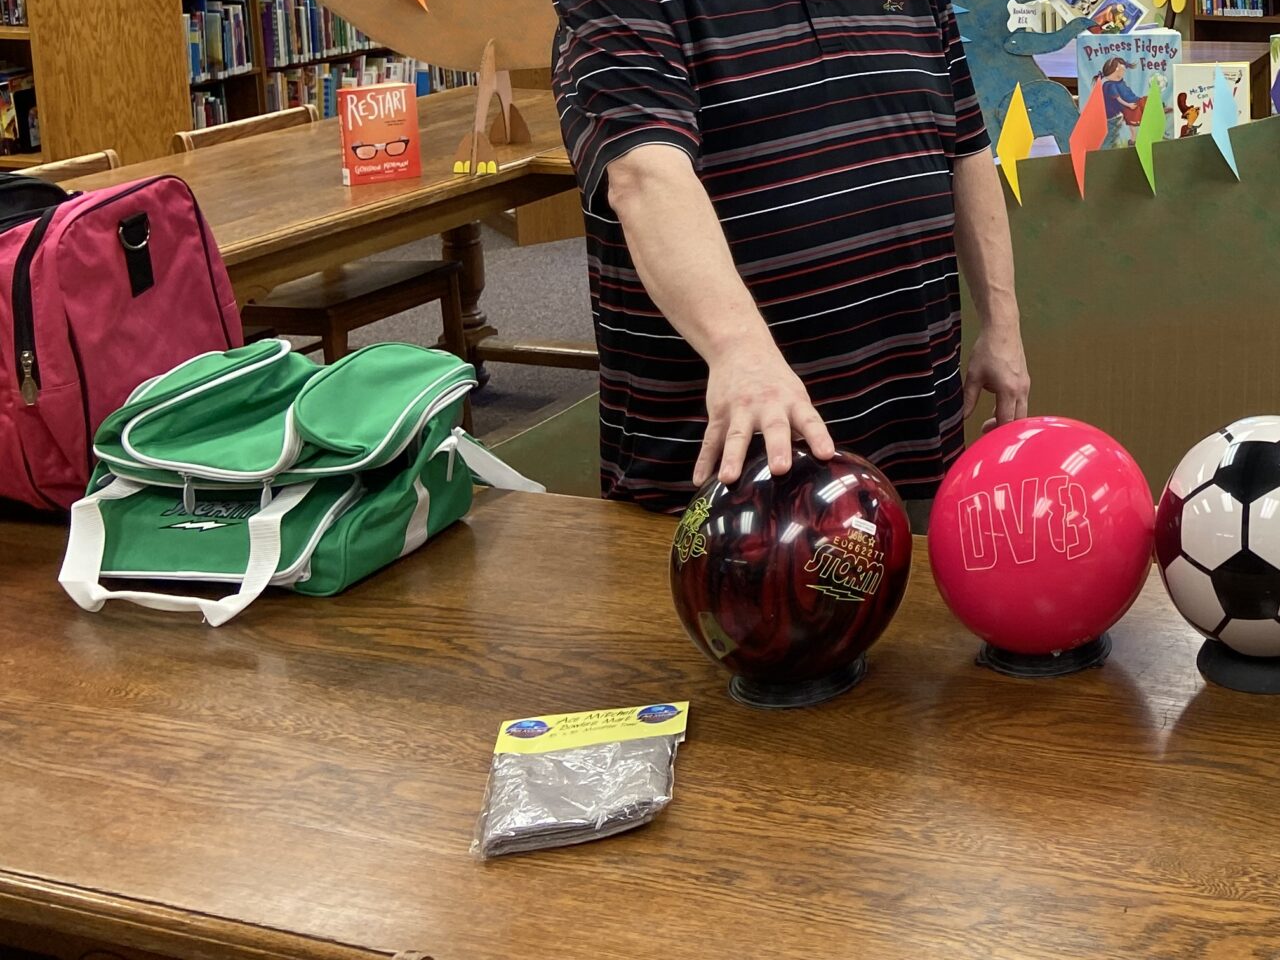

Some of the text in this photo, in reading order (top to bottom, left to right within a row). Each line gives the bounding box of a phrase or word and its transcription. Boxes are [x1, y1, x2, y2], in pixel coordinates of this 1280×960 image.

[1083, 38, 1178, 61] Princess Fidgety
[1140, 57, 1168, 71] Feet
[957, 475, 1093, 572] DV8
[803, 543, 885, 595] STORM
